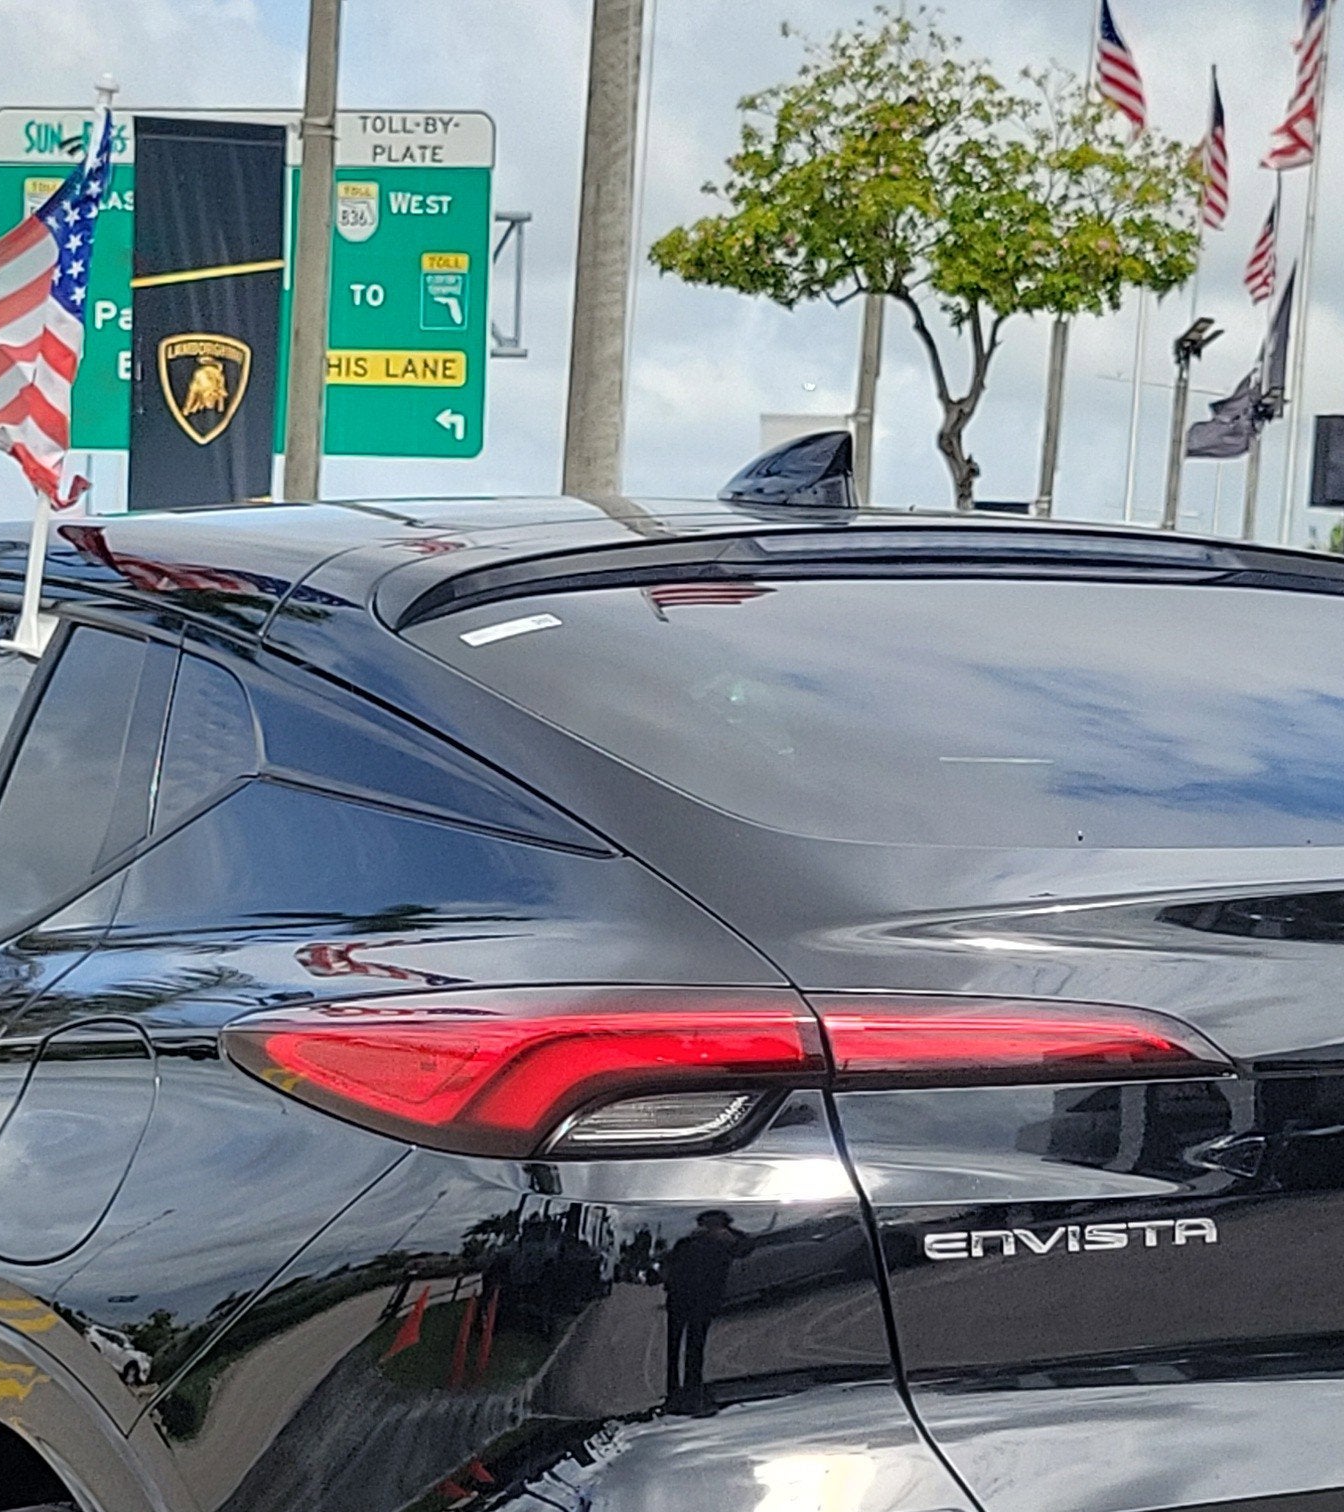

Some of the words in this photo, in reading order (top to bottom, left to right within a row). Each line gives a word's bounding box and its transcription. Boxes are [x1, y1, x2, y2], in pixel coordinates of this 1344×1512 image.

[372, 145, 444, 163] PLATE
[389, 191, 452, 214] WEST
[349, 284, 385, 307] TO
[385, 358, 456, 379] LANE
[924, 1217, 1218, 1260] ENVISTA
